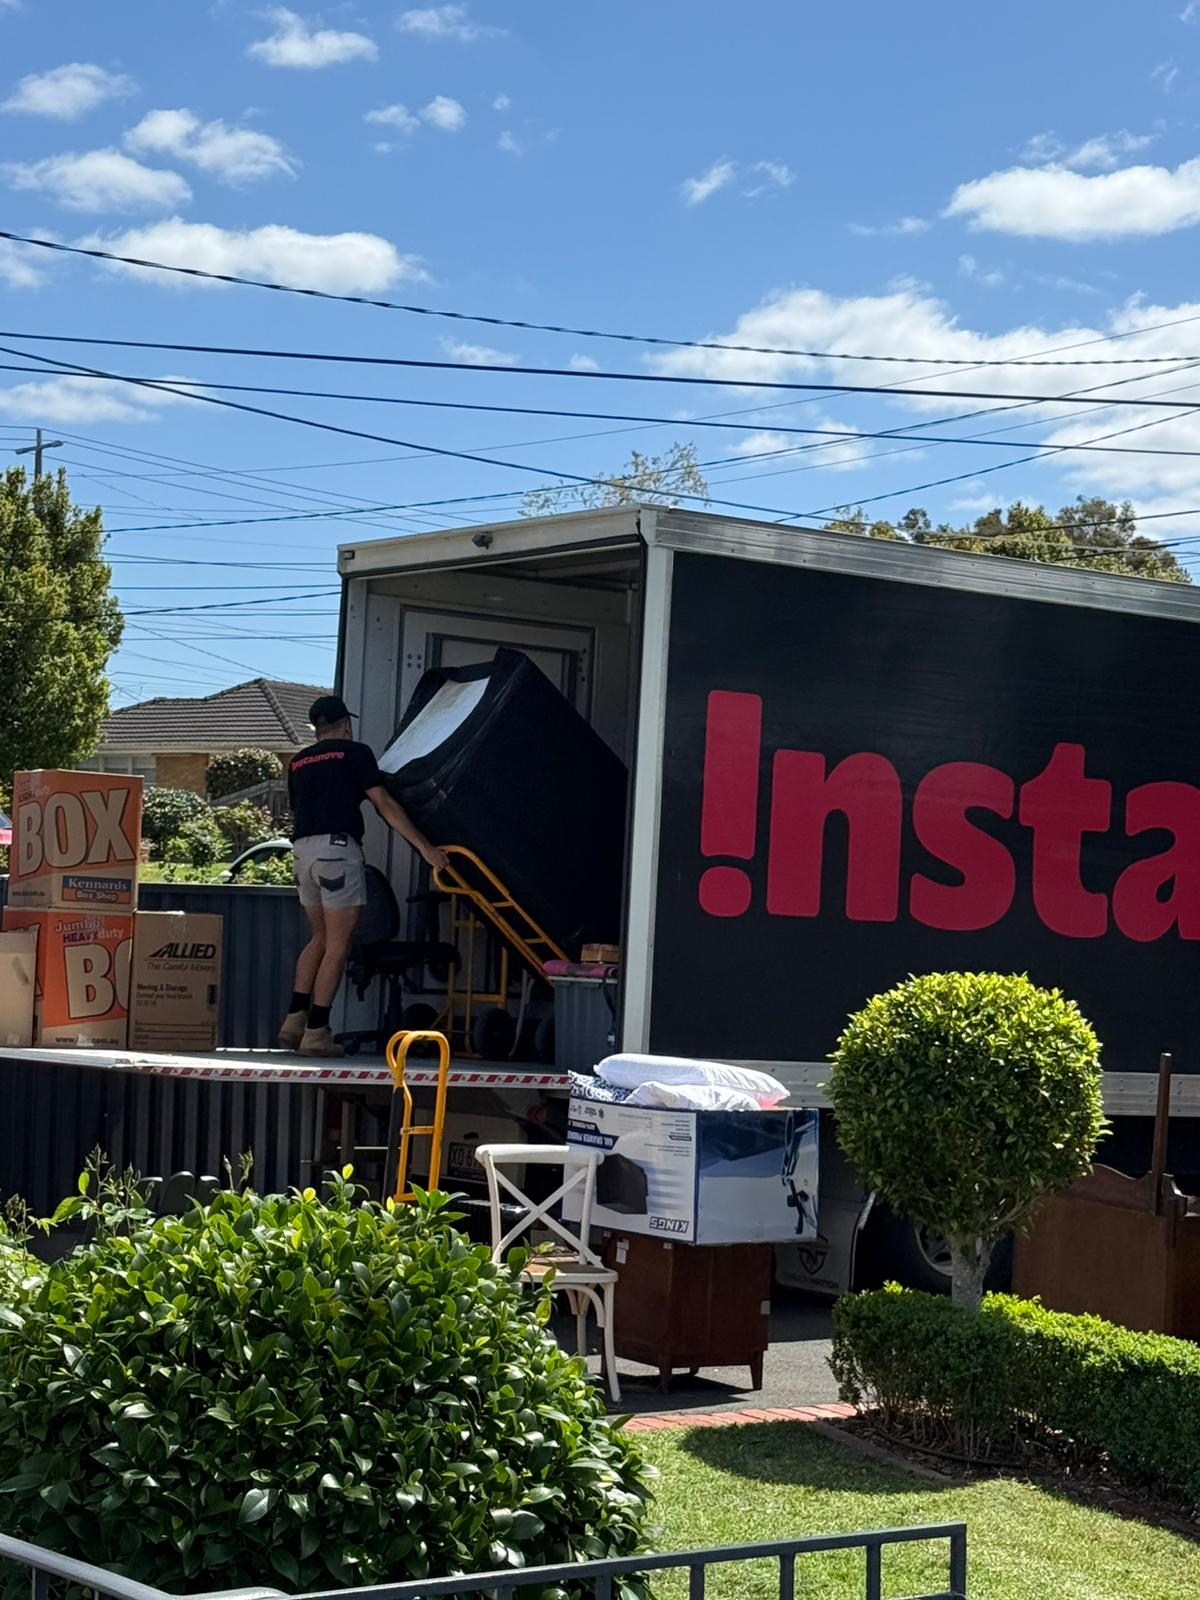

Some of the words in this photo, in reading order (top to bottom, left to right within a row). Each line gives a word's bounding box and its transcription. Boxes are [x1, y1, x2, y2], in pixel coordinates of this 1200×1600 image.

[18, 788, 137, 877] BOX
[68, 877, 127, 890] Kennards
[55, 919, 100, 932] Jumbo
[97, 928, 124, 939] duty
[149, 943, 216, 959] ALLIED
[649, 1216, 689, 1234] KINGS
